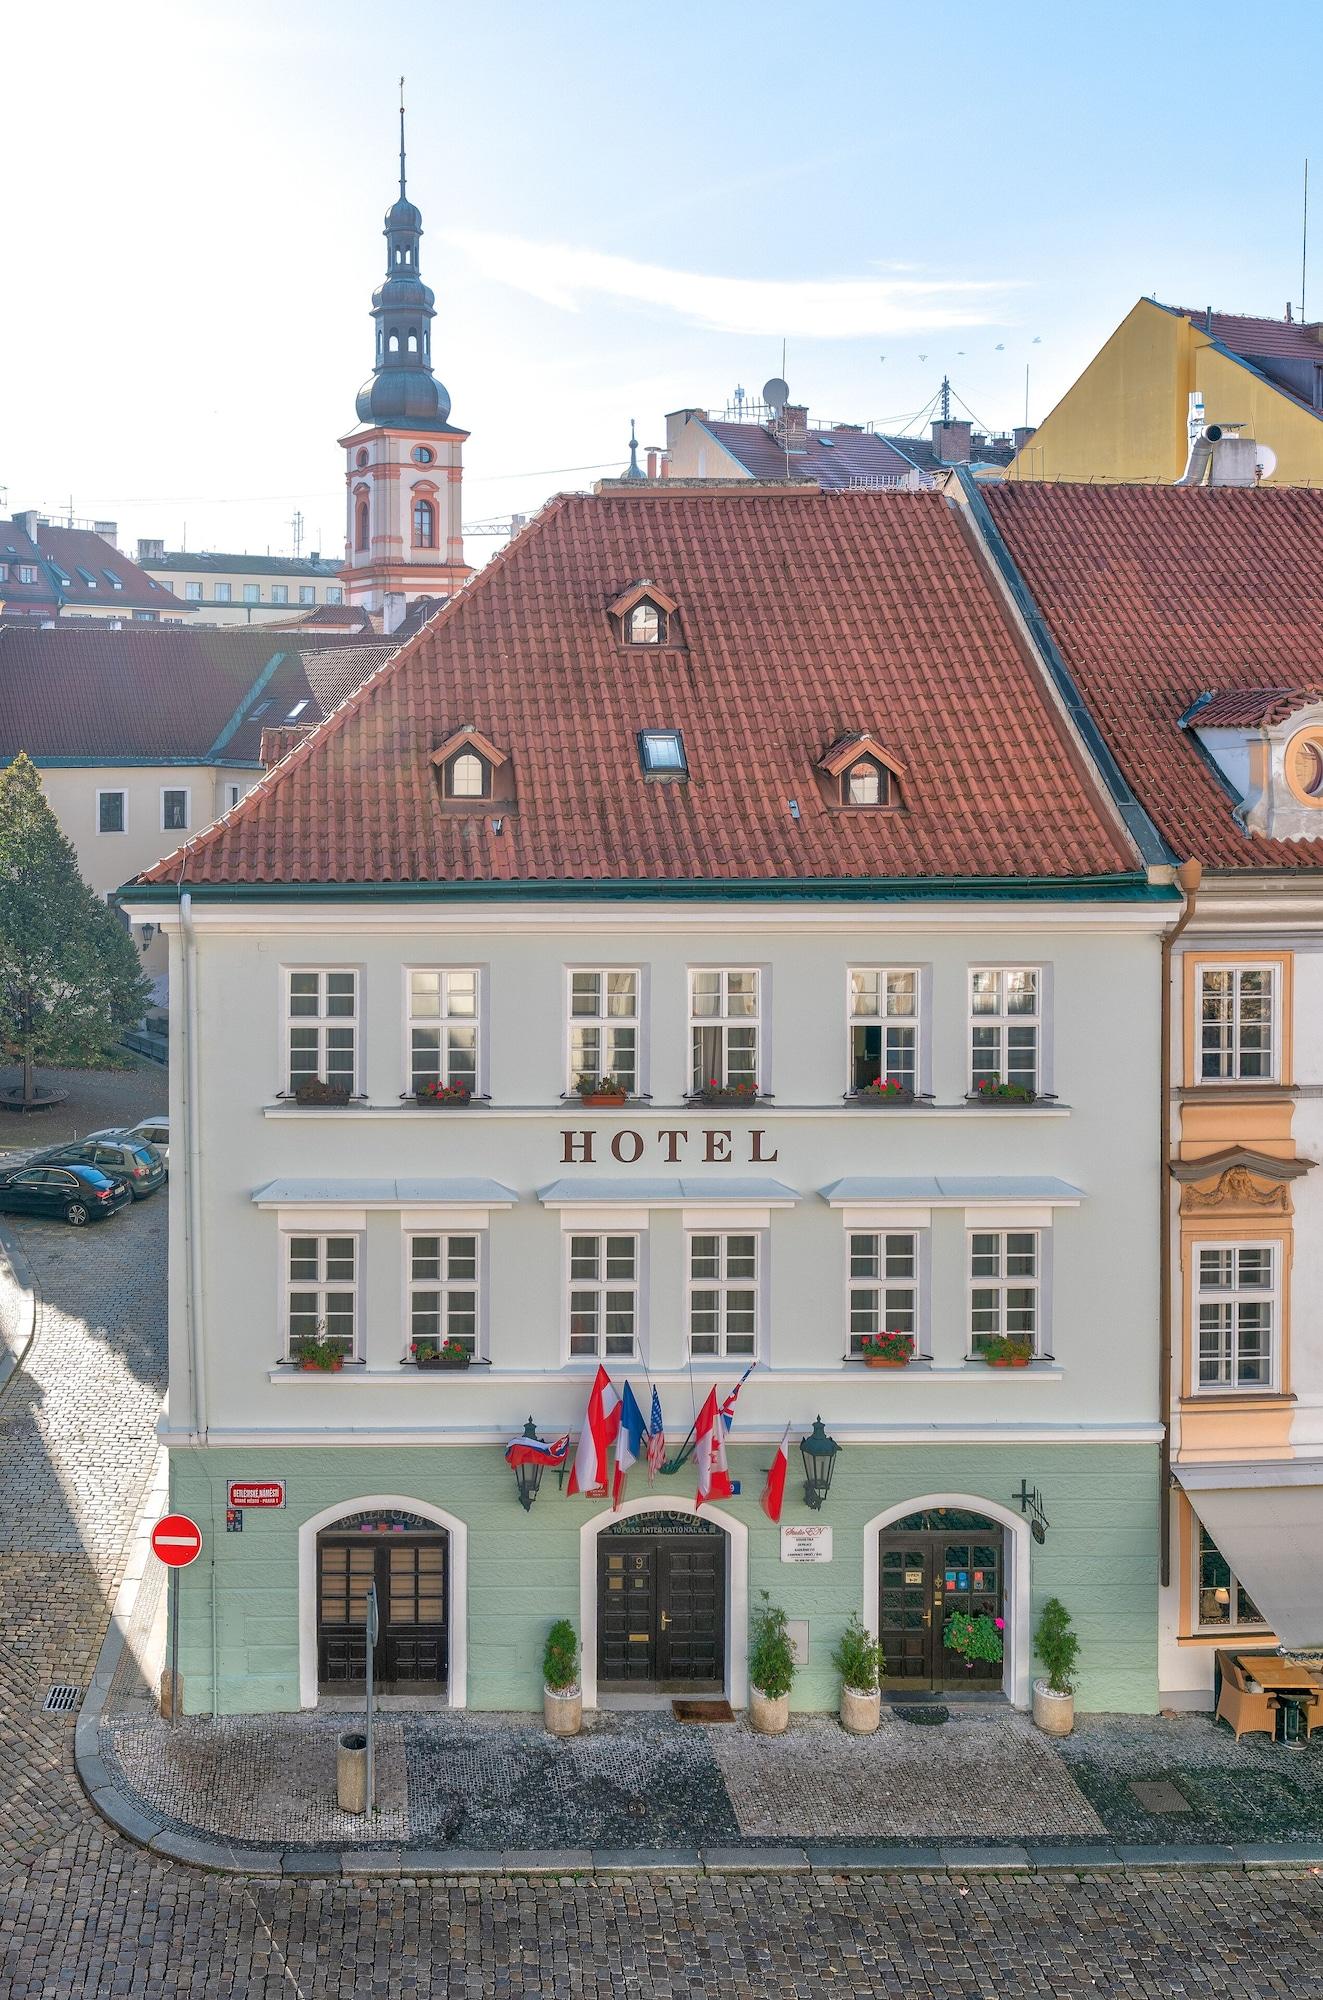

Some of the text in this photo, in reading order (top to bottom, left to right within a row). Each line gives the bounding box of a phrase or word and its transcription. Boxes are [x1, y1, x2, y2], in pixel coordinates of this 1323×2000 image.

[559, 1130, 778, 1163] HOTEL
[391, 1511, 423, 1526] CLUB
[668, 1511, 702, 1527] CLUB
[642, 1526, 698, 1534] INTERNATIONAL
[636, 1557, 643, 1569] 9
